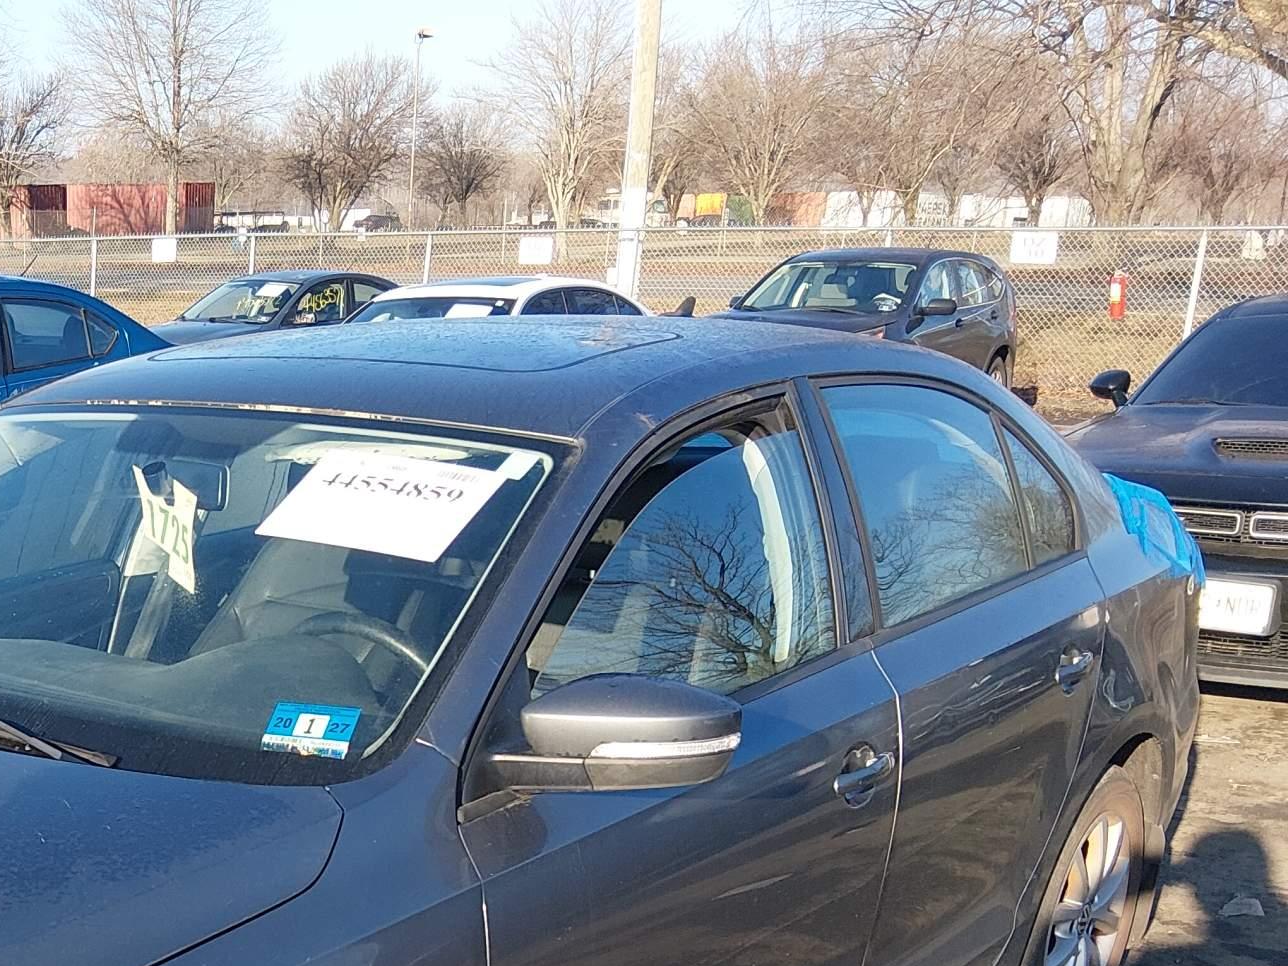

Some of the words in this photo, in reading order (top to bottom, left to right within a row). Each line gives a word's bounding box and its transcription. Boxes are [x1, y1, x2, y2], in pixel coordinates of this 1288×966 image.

[322, 472, 464, 502] 44554859
[146, 498, 189, 565] 1725
[273, 716, 292, 729] 20
[303, 718, 316, 735] 1
[328, 722, 352, 734] 27
